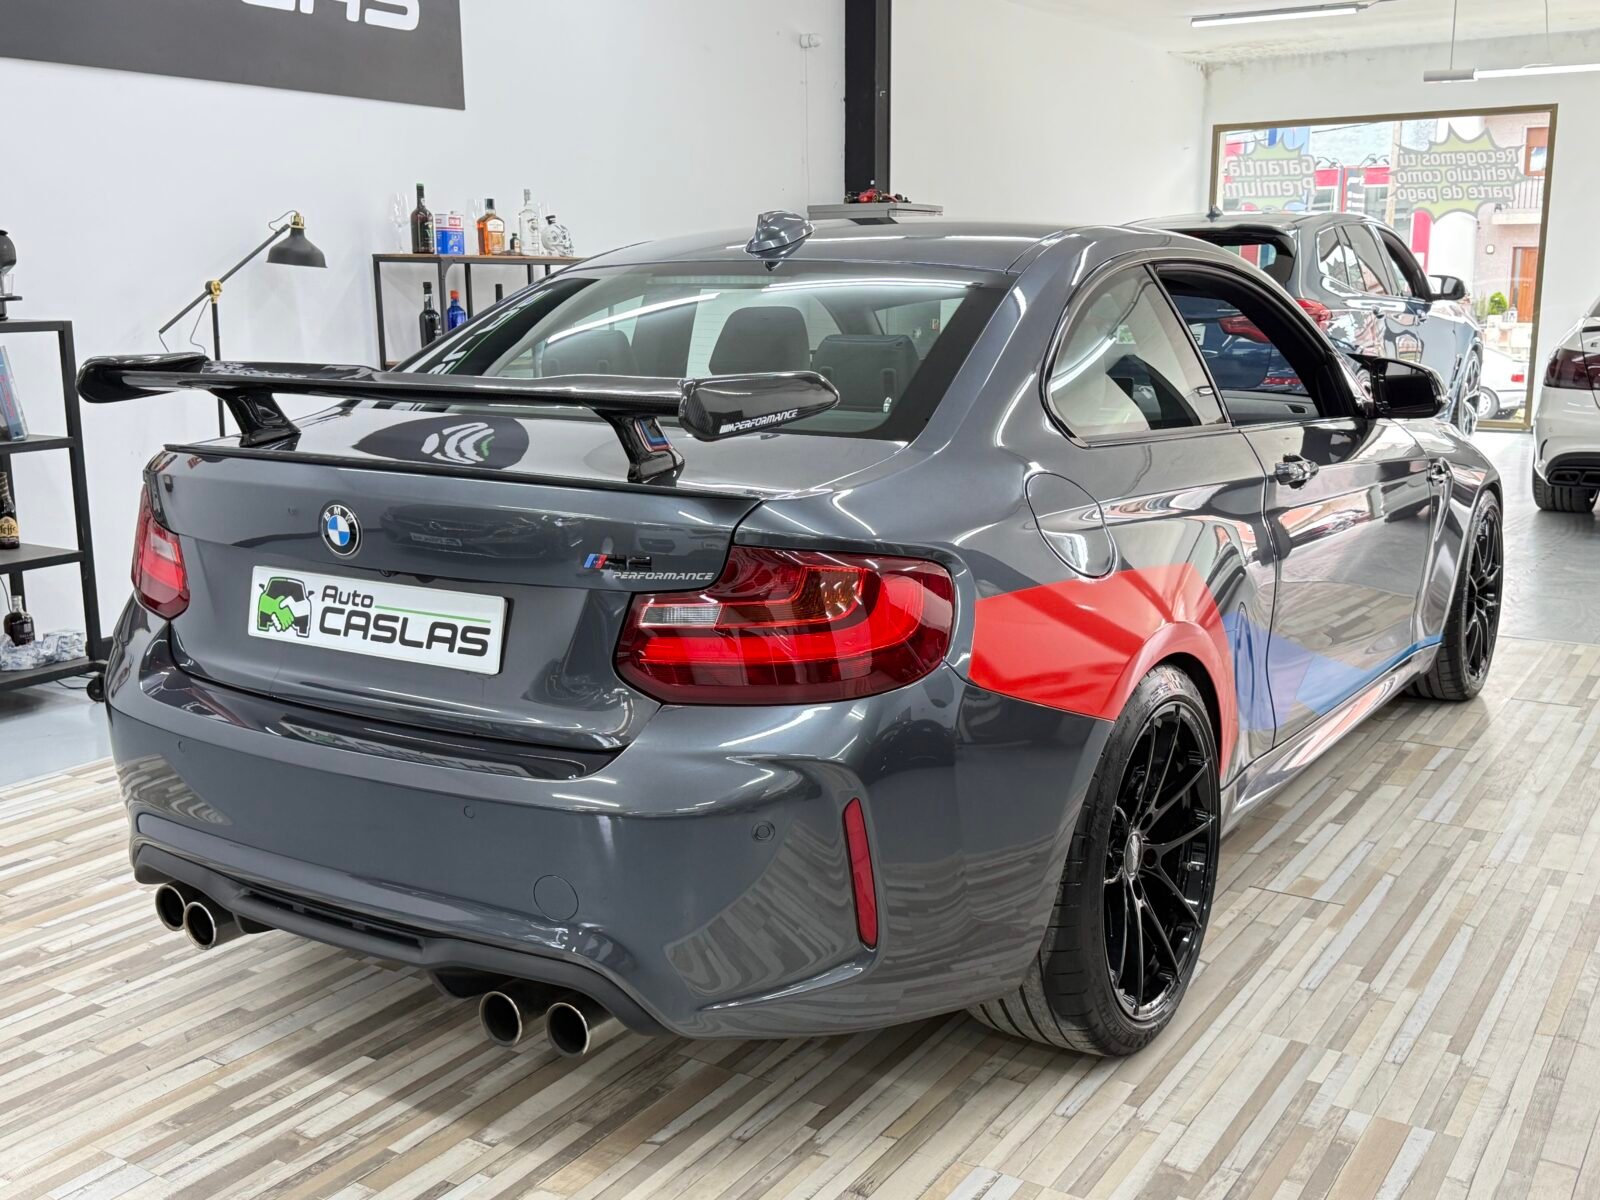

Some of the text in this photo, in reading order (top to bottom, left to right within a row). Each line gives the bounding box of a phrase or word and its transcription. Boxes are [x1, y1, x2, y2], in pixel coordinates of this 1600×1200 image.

[323, 505, 355, 524] BMW
[611, 570, 715, 581] PERFORMANCE
[320, 584, 375, 608] Auto
[318, 605, 492, 658] CASLAS
